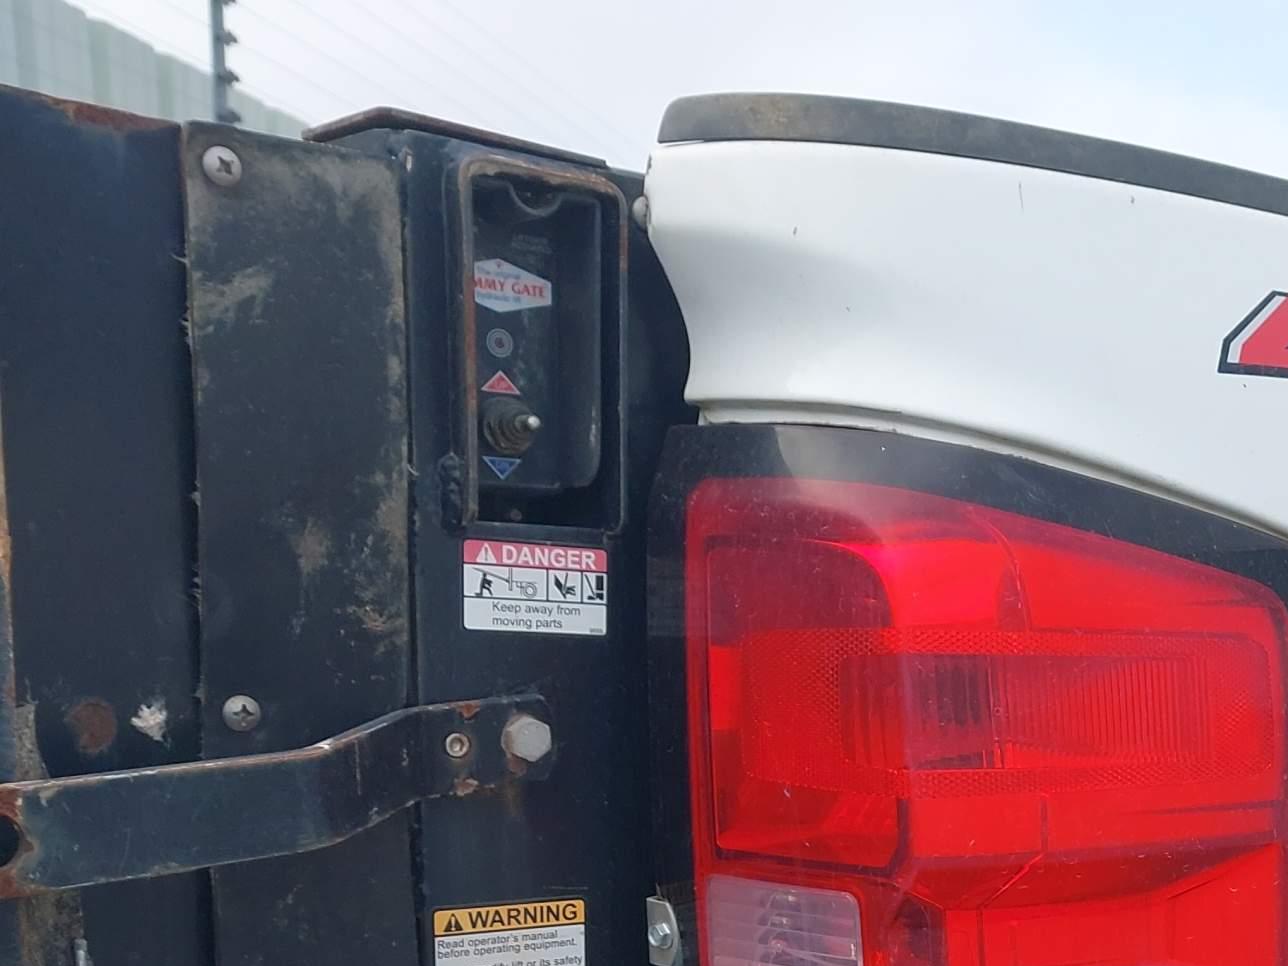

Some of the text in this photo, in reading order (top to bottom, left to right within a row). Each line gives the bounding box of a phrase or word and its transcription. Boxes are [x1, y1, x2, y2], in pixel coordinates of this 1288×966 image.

[512, 282, 545, 297] GATE
[502, 545, 596, 569] DANGER
[492, 602, 580, 616] Keep away from
[492, 617, 562, 629] moving parts
[468, 903, 578, 928] WARNING
[437, 930, 558, 949] Read operator's manual
[437, 938, 577, 959] before operating equipment.
[540, 959, 550, 966] its
[554, 956, 582, 966] safety
